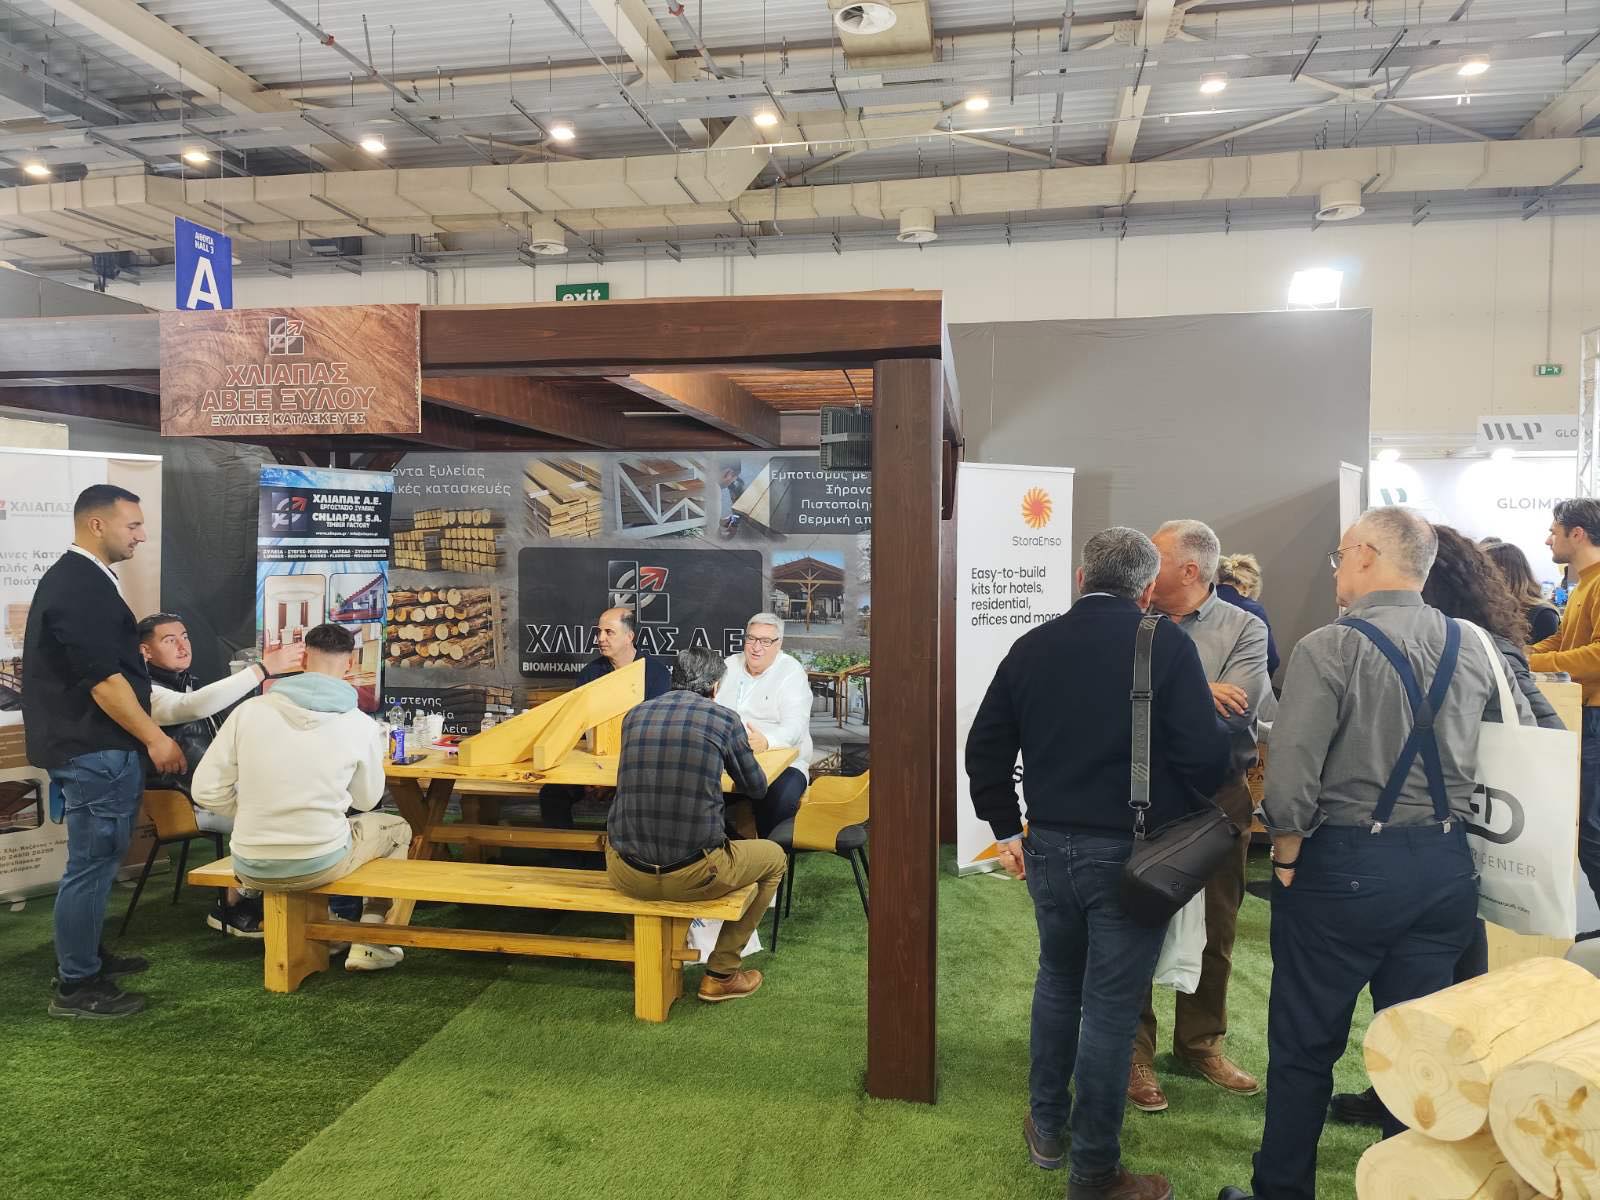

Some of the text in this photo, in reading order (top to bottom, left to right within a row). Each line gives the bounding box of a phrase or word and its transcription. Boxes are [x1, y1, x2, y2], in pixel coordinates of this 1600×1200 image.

[186, 256, 223, 311] A
[226, 363, 349, 387] ΧΛΙΑΠΑΣ
[201, 387, 376, 412] ΑΒΕΕ ΞΥΛΟΥ
[211, 412, 366, 427] ΞΥΛΙΝΕΣ ΚΑΤΑΣΚΕΥΕΣ
[429, 463, 485, 479] ξυλείας
[425, 482, 511, 497] κατασκευές
[312, 493, 362, 505] ΧΛΙΑΠΑΣ
[801, 498, 872, 512] Πιστοποίη
[311, 512, 383, 523] CHLIAPAS S.A.
[798, 513, 850, 526] Θερμική
[1012, 535, 1062, 547] StoraEnso
[971, 566, 1046, 582] Easy-to-build
[971, 581, 1044, 595] kits for hotels,
[971, 597, 1031, 611] residential,
[971, 612, 1008, 626] offices
[1009, 612, 1031, 625] and
